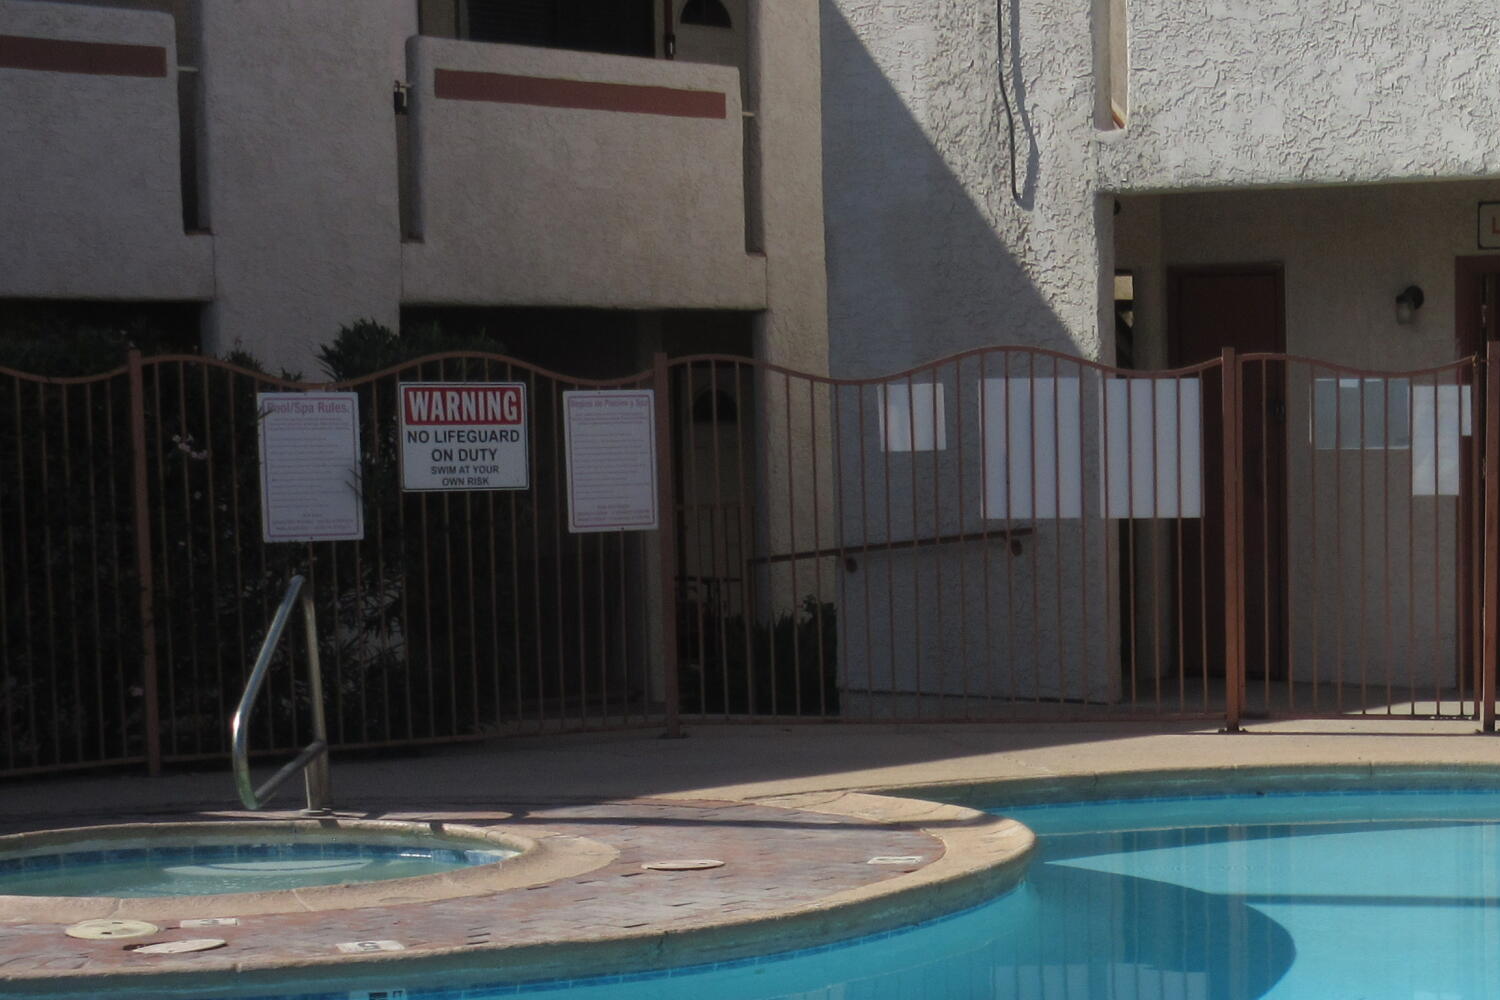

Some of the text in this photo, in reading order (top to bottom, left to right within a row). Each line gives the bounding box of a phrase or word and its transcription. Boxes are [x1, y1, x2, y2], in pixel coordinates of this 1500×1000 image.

[408, 390, 518, 422] WARNING
[407, 429, 520, 443] NO LIFEGUARD
[431, 448, 498, 462] ON DUTY
[431, 464, 500, 475] SWIM AT YOUR
[442, 476, 489, 486] OWN RISK
